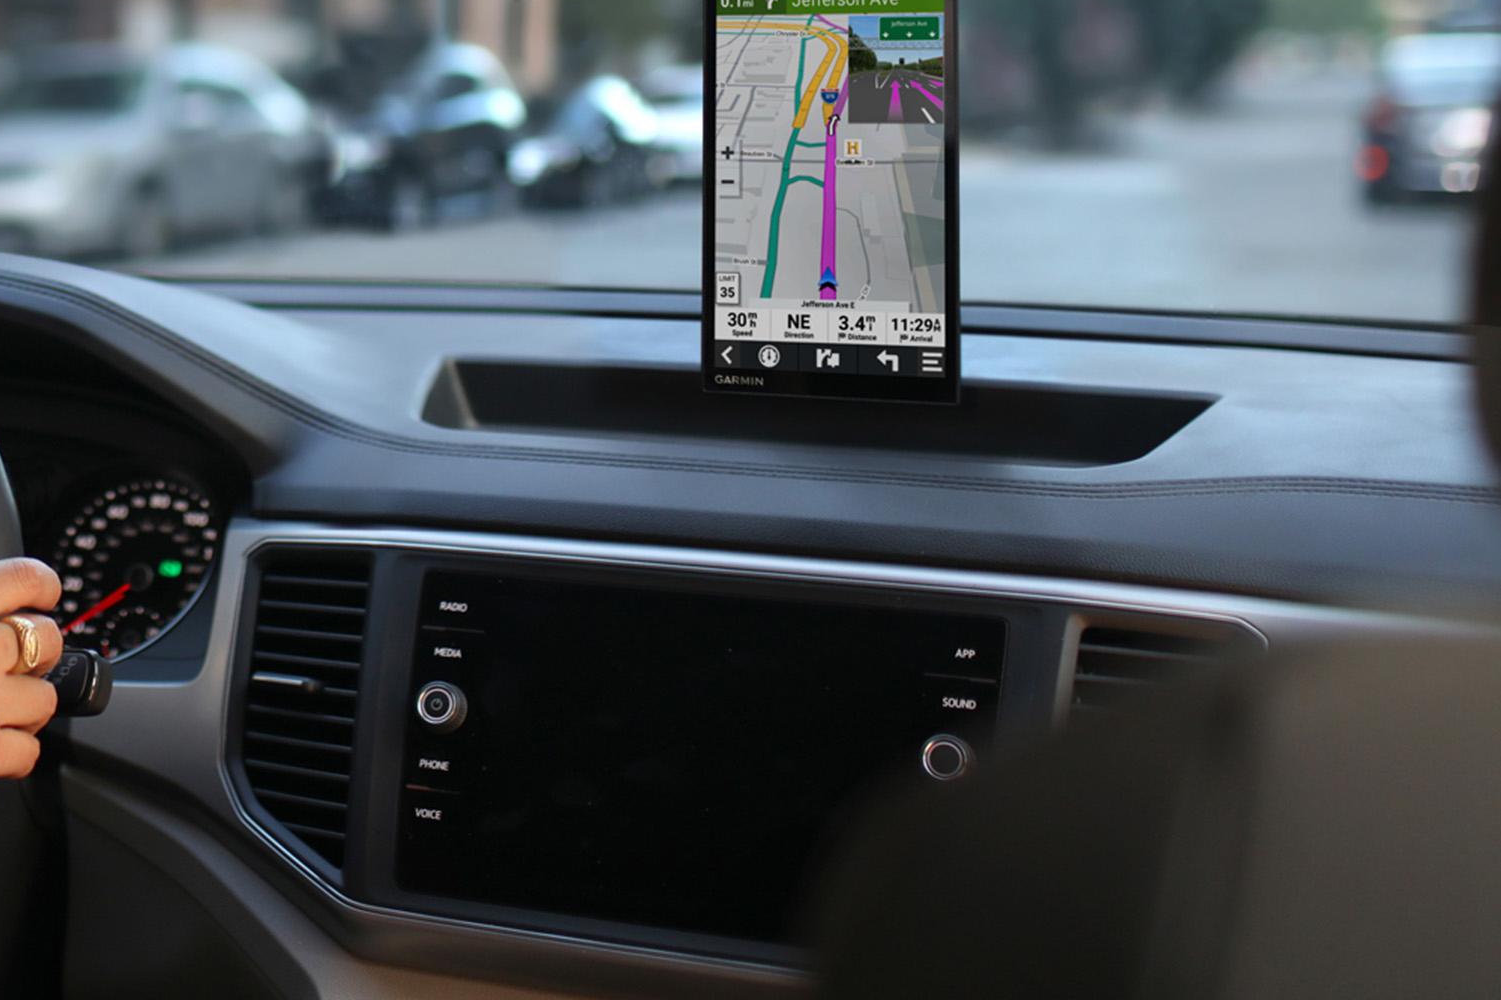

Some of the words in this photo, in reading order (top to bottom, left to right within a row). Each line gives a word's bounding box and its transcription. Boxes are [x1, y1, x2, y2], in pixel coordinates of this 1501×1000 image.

[720, 286, 736, 298] 35
[801, 300, 834, 309] Jefferson
[835, 301, 849, 309] Ave
[727, 312, 747, 328] 30
[787, 314, 811, 329] NE
[838, 315, 865, 331] 3.4
[732, 329, 753, 337] Speed
[784, 331, 814, 339] Direction
[847, 333, 877, 341] Distance
[714, 374, 765, 386] GARMIN
[439, 601, 468, 613] RADIO
[433, 647, 462, 659] MEDIA
[955, 648, 976, 659] APP
[942, 696, 977, 710] SOUND
[419, 758, 450, 771] PHONE
[415, 807, 442, 820] VOICE
